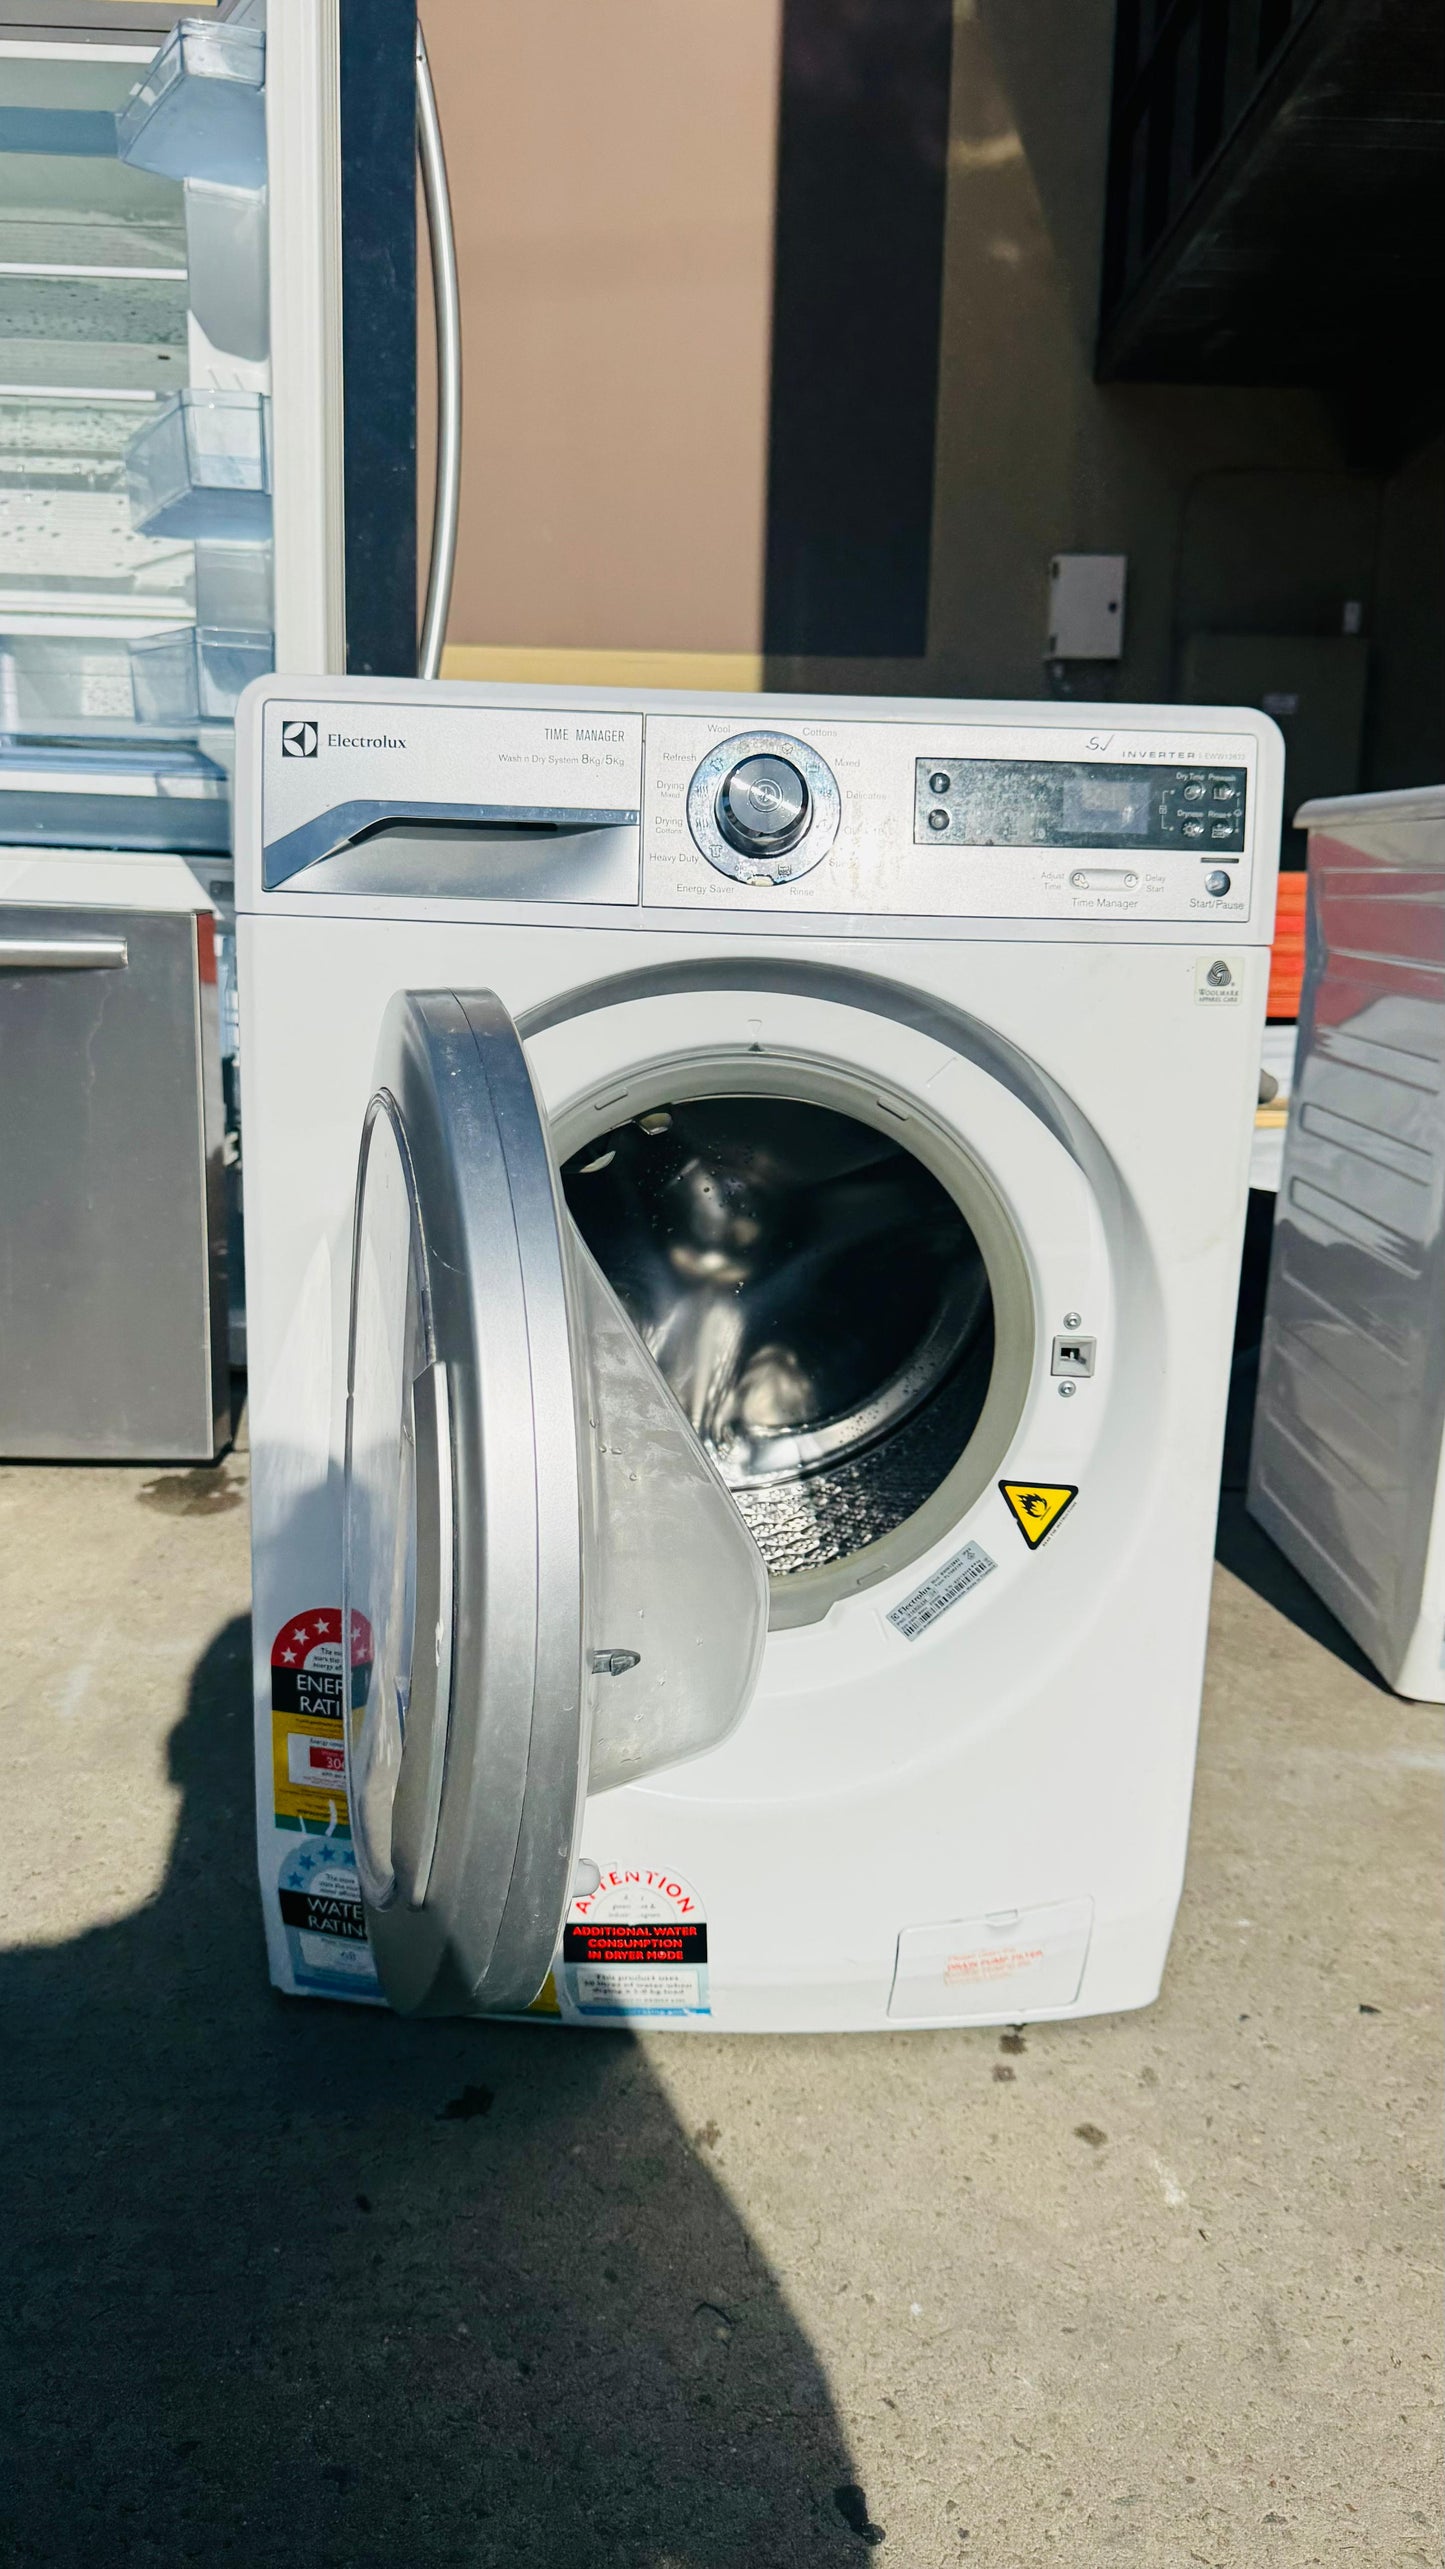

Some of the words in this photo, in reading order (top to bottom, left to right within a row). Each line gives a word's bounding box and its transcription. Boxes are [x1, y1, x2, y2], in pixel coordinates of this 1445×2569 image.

[707, 724, 731, 734] Wool
[802, 727, 838, 737] Cottons
[544, 727, 569, 741] TIME
[575, 729, 625, 743] MANAGER
[327, 733, 407, 750] Electrolux
[498, 753, 522, 763] Wash
[531, 754, 545, 766] Dry
[547, 755, 579, 766] System
[663, 753, 697, 762] Refresh
[1122, 751, 1195, 759] INVERTER
[834, 758, 860, 768] Mixed
[656, 780, 685, 791] Drying
[661, 791, 680, 799] Mixed
[655, 816, 683, 828] Drying
[649, 853, 677, 864] Heavy
[679, 853, 700, 864] Duty
[1041, 871, 1065, 882] Adjust
[1145, 873, 1166, 885] Delay
[676, 884, 706, 895] Energy
[709, 885, 734, 894] Saver
[789, 887, 814, 897] Rinse
[1044, 882, 1061, 891] Time
[1146, 884, 1164, 894] Start
[1072, 898, 1095, 908] Time
[1097, 899, 1139, 911] Manager
[1189, 898, 1245, 911] Start/Pause
[898, 1586, 932, 1615] Electrolux
[297, 1674, 343, 1695] ENER
[300, 1696, 341, 1716] RATI
[307, 1896, 364, 1921] WATE
[308, 1914, 364, 1937] RATIN
[572, 1926, 652, 1936] ADDITIONAL
[653, 1926, 698, 1936] WATER
[587, 1938, 683, 1949] CONSUMPTION
[588, 1950, 602, 1960] IN
[605, 1950, 645, 1961] DRYER
[646, 1950, 684, 1961] MODE
